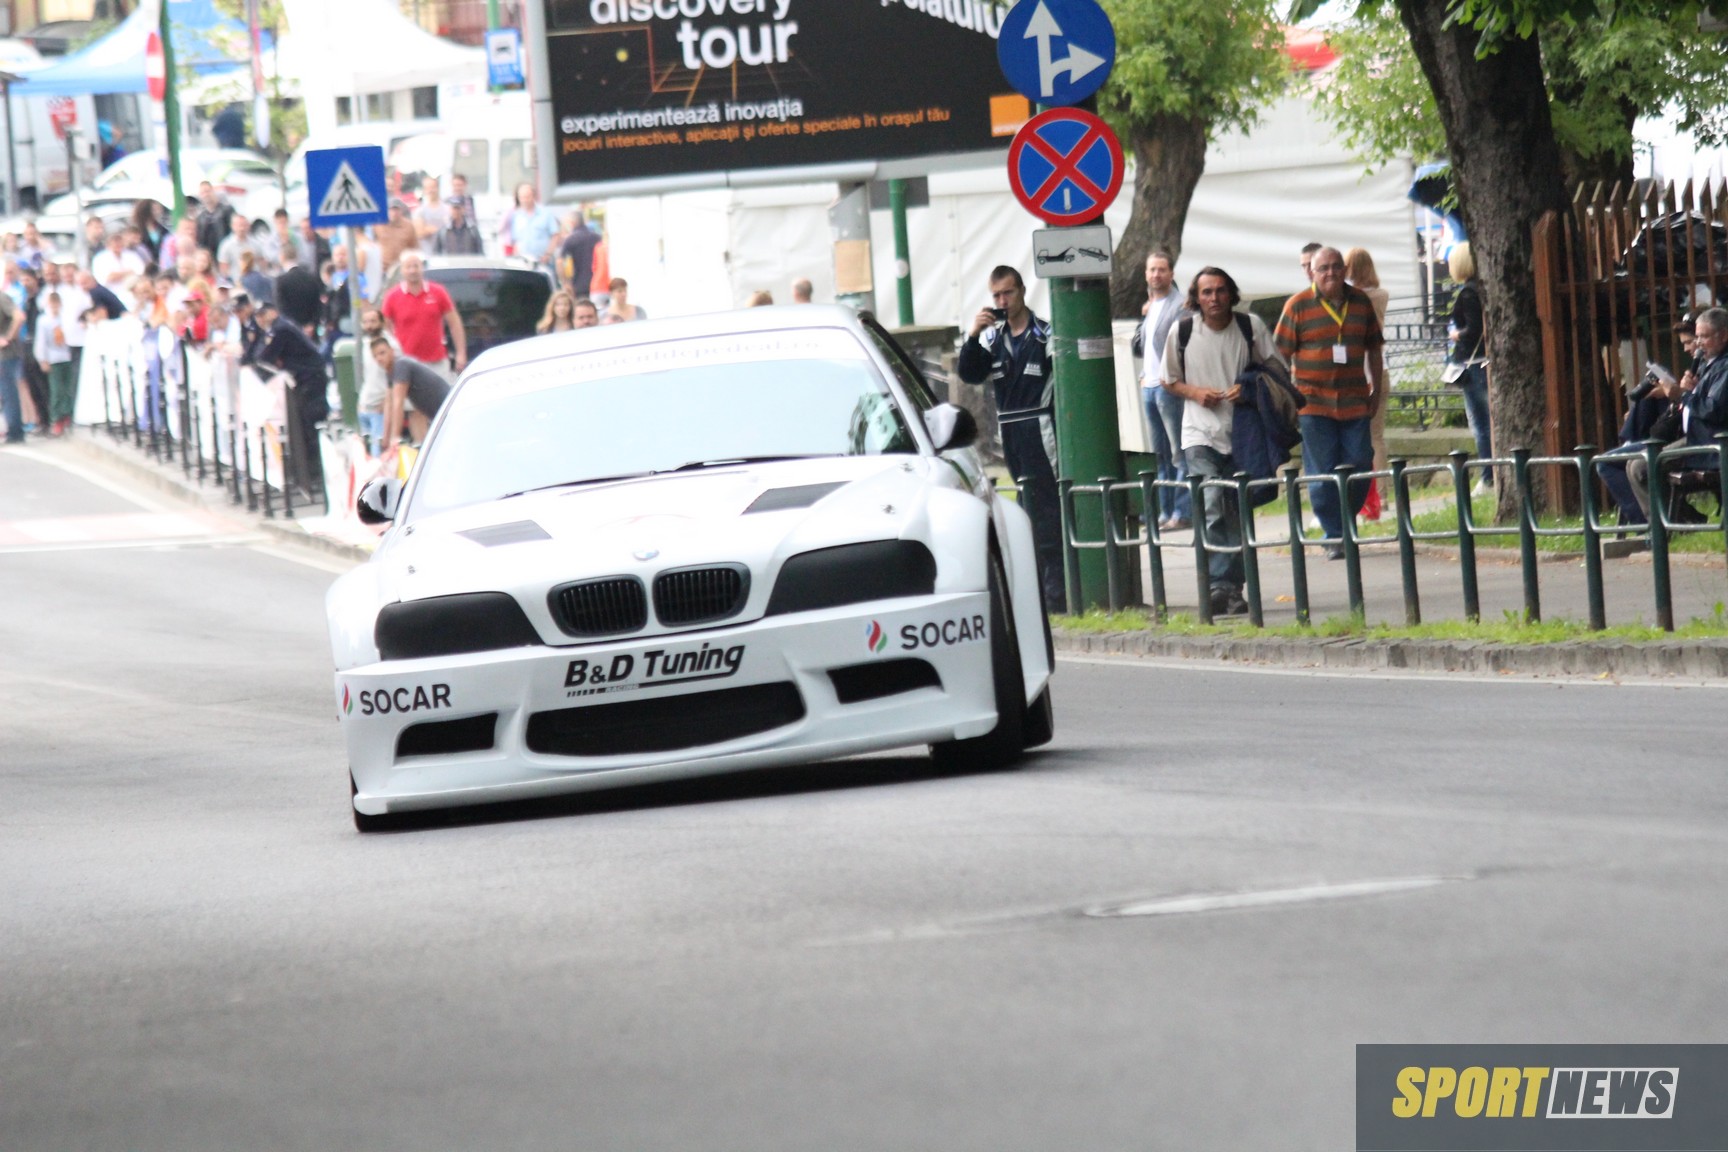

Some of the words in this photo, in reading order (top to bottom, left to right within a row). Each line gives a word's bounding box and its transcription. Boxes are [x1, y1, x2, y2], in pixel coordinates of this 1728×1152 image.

[676, 20, 798, 69] tour
[561, 103, 720, 136] experimentează
[803, 115, 861, 136] speciale
[900, 614, 986, 650] SOCAR
[564, 654, 634, 688] B&D
[643, 643, 746, 678] Tuning
[359, 683, 452, 716] SOCAR
